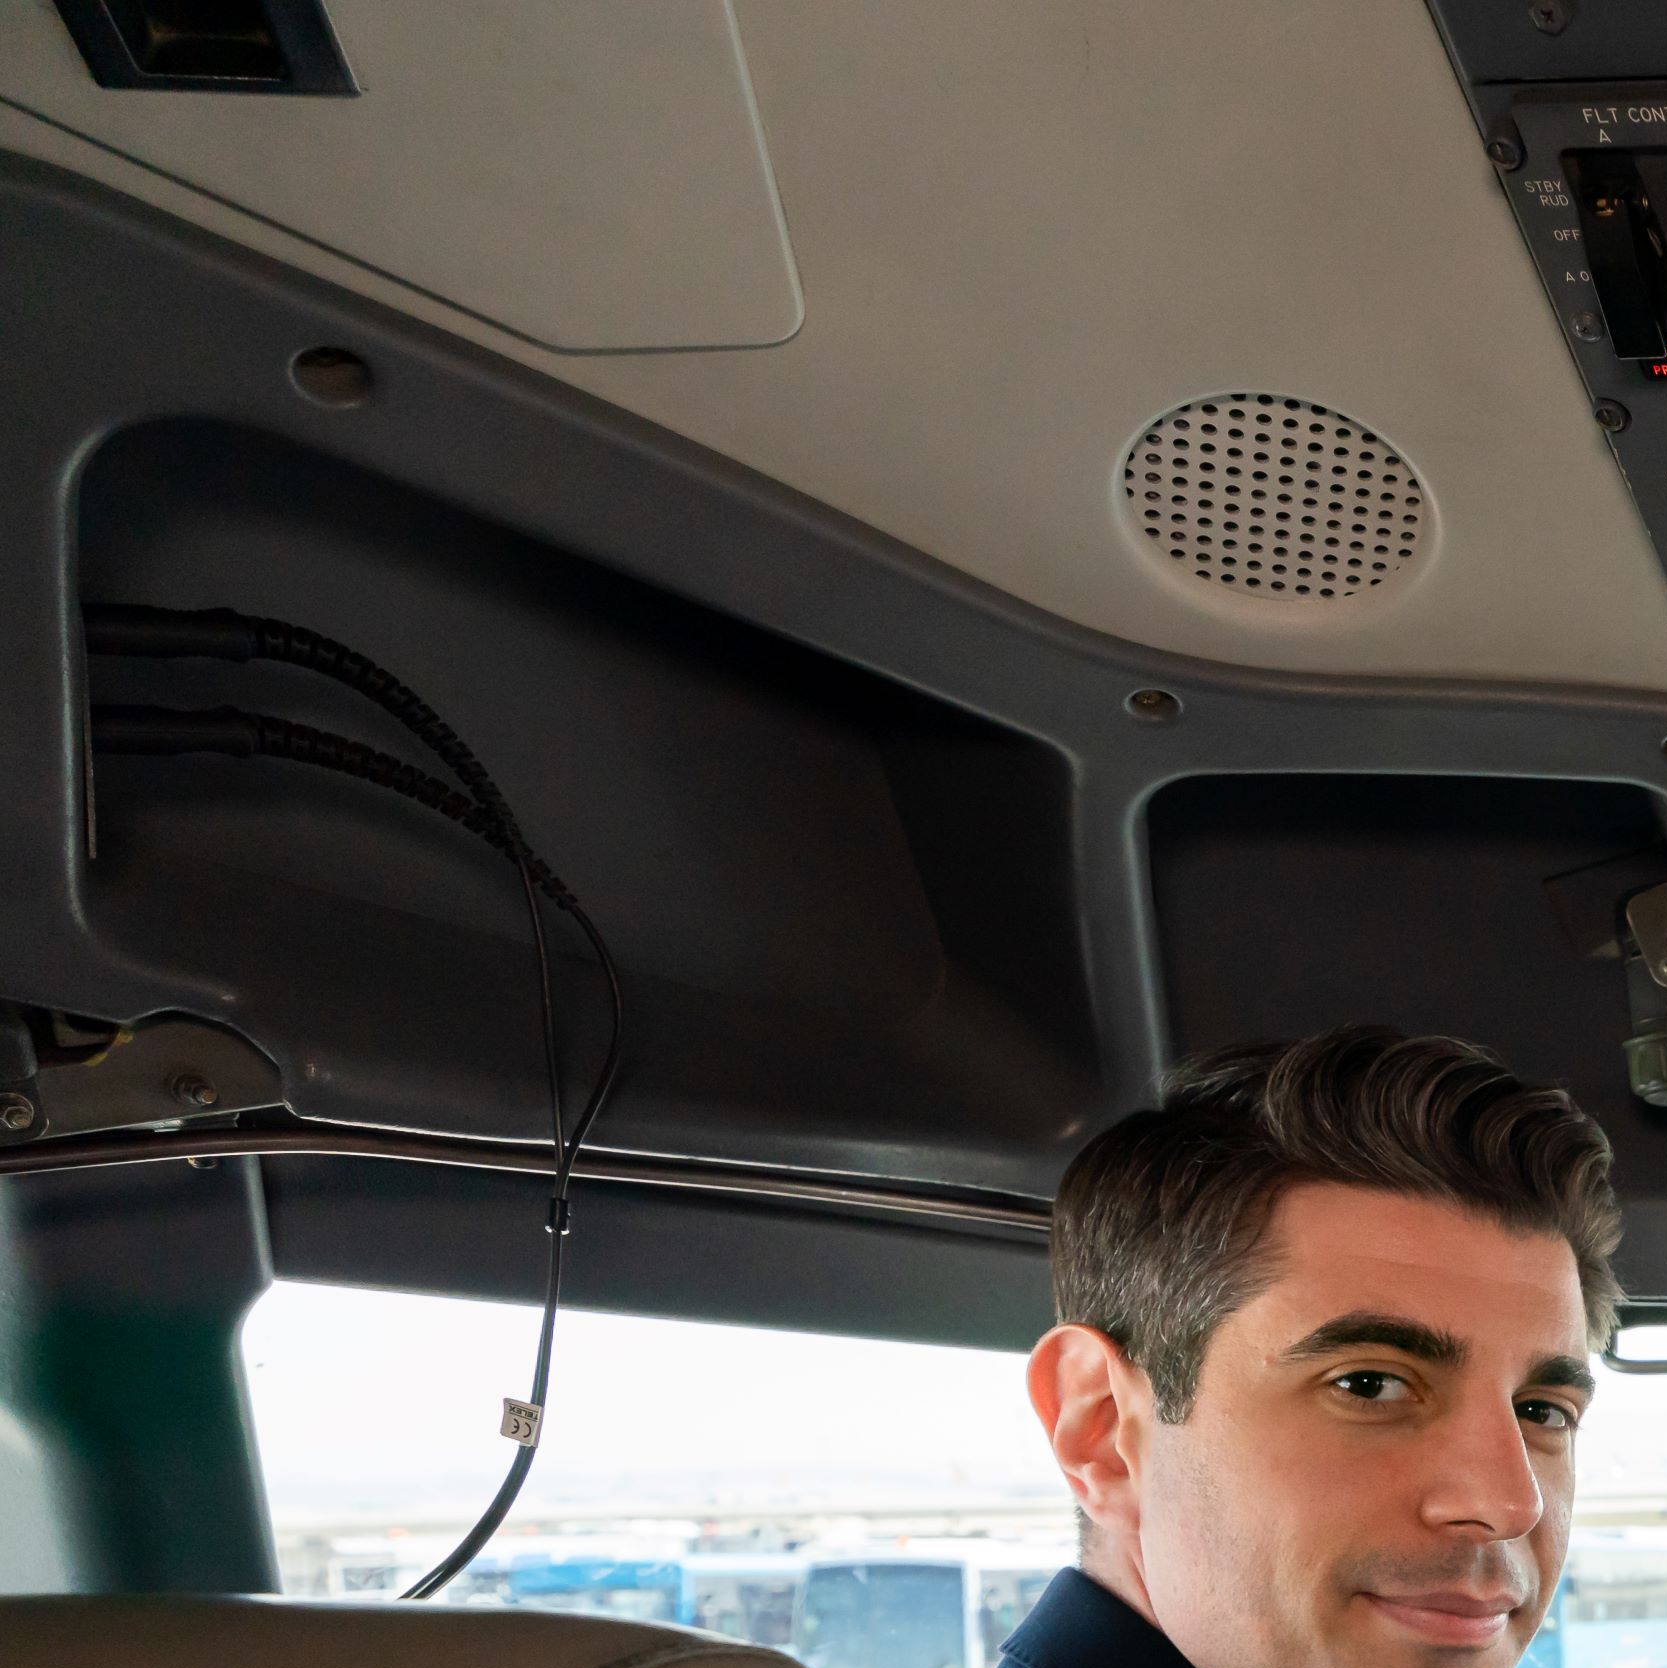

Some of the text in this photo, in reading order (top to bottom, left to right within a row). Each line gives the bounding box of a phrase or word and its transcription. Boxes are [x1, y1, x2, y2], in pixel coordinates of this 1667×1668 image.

[1582, 107, 1622, 125] FLT
[1524, 180, 1562, 194] STBY
[1540, 193, 1569, 207] RUD
[1553, 229, 1582, 242] OFF
